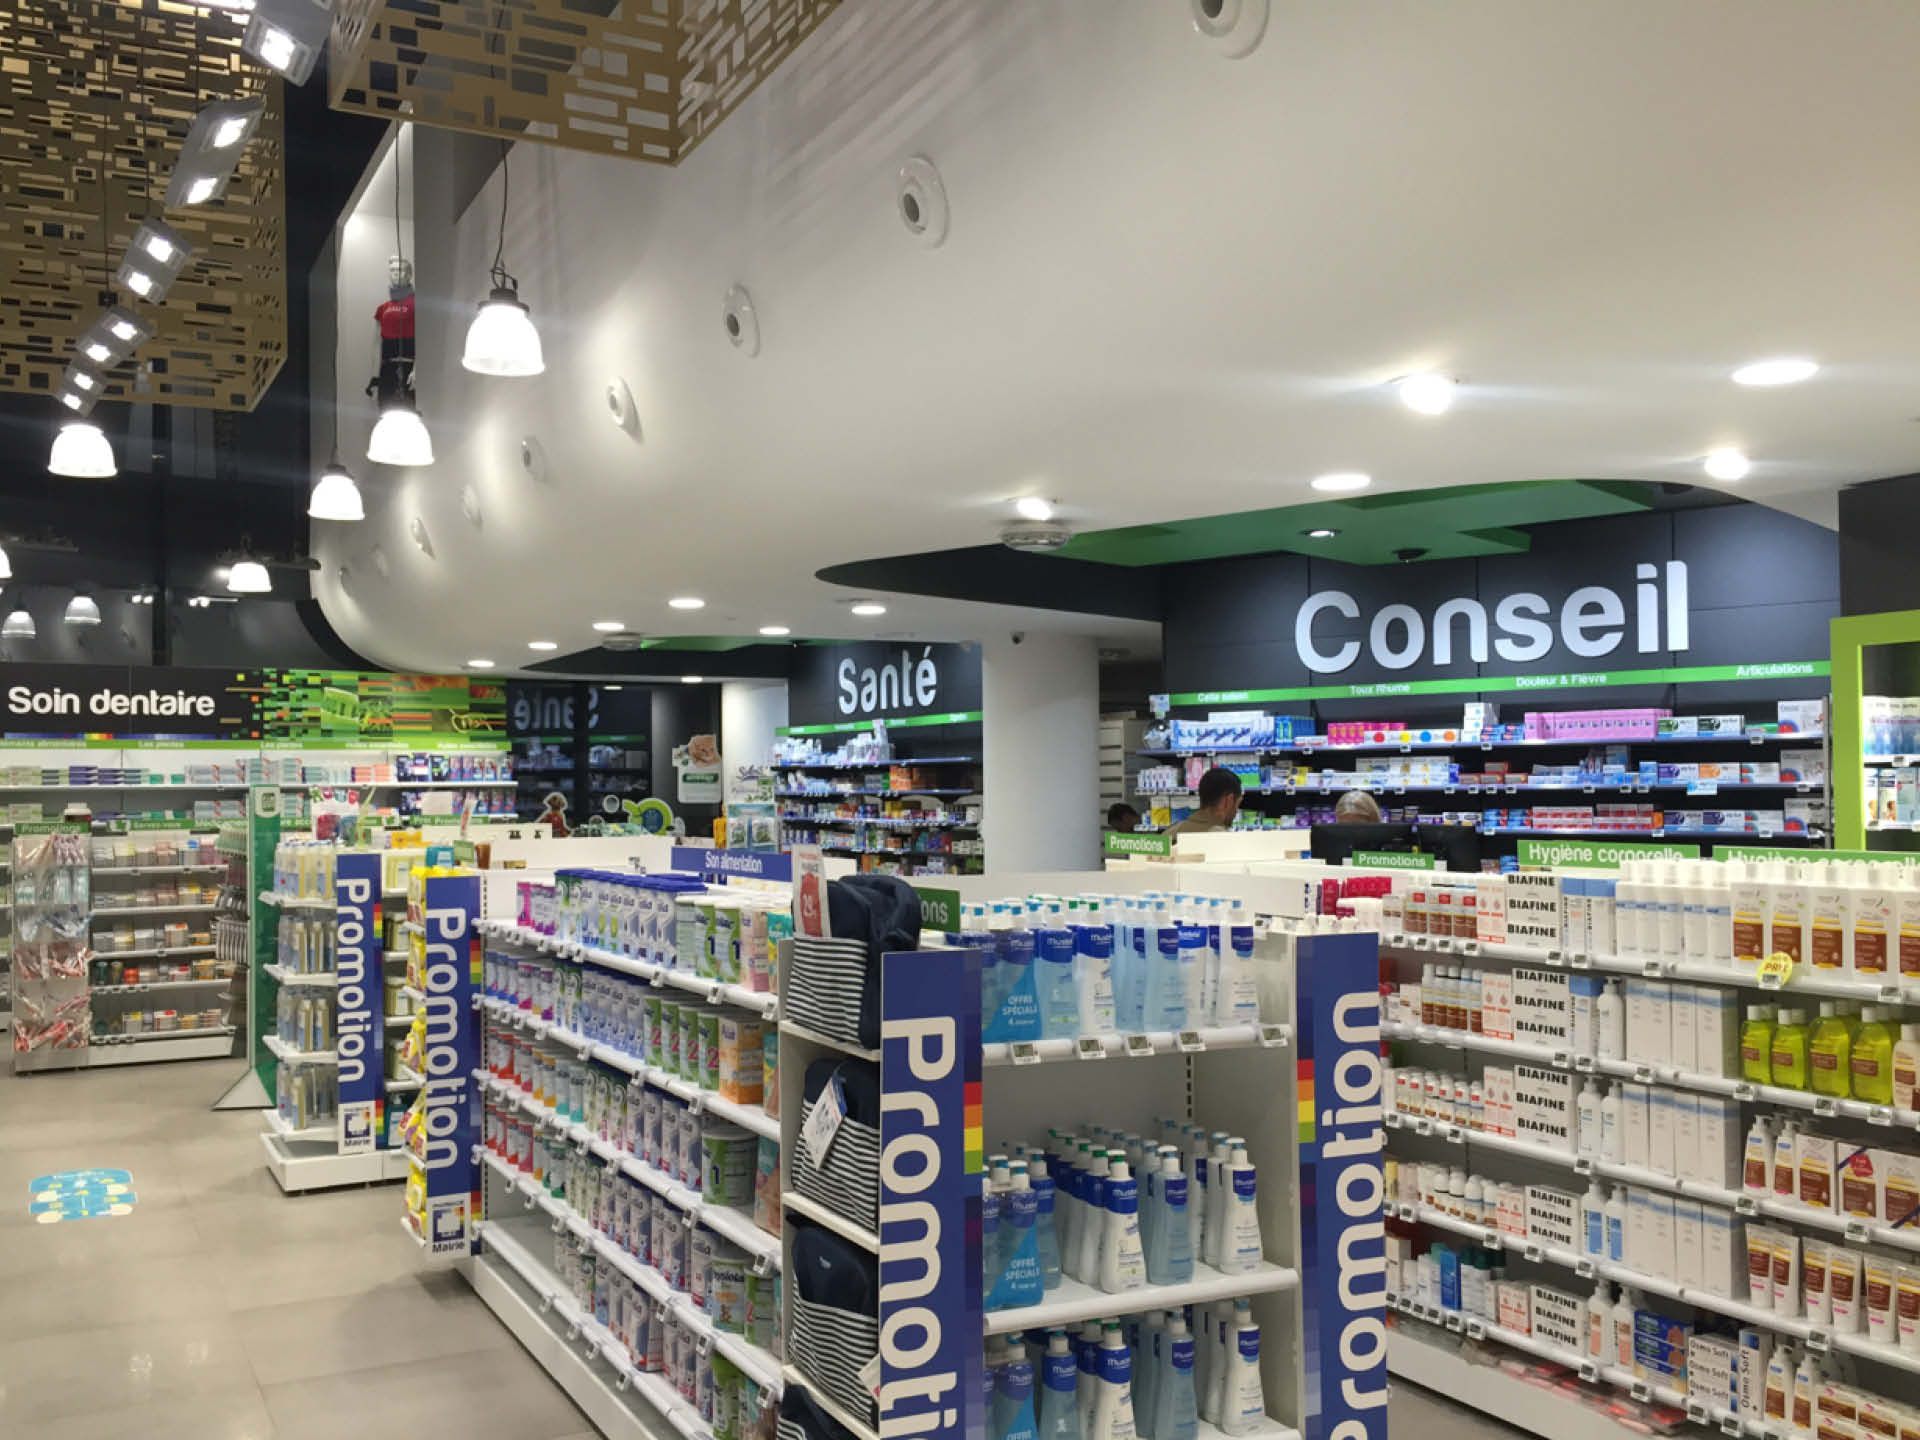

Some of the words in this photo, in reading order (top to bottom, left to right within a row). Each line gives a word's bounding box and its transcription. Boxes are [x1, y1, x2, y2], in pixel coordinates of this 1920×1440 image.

[1295, 560, 1690, 674] Conseil
[1735, 662, 1814, 677] Articulations
[838, 646, 937, 715] Santé
[1515, 675, 1557, 688] Douleur
[1559, 674, 1568, 685] &
[1570, 672, 1608, 684] Fièvre
[8, 686, 80, 714] Soin
[89, 688, 216, 716] dentaire
[22, 823, 81, 833] Promotions
[1110, 835, 1164, 852] Promotions
[705, 850, 720, 868] Son
[720, 852, 762, 873] alimentation
[1358, 853, 1426, 868] Promotions
[1529, 843, 1592, 866] Hygiène
[1508, 875, 1555, 886] BIAFINE
[1509, 899, 1557, 912] BIAFINE
[1507, 924, 1557, 937] BIAFINE
[336, 878, 371, 1083] Promotion
[1516, 970, 1566, 984] BIAFINE
[1515, 995, 1565, 1011] BIAFINE
[426, 907, 467, 1169] Promotion
[651, 1027, 662, 1045] 2
[1516, 1021, 1566, 1037] BIAFINE
[670, 1034, 680, 1053] 2
[688, 1040, 699, 1061] 2
[707, 1048, 720, 1069] 2
[1518, 1067, 1568, 1085] BIAFINE
[1516, 1093, 1565, 1111] BIAFINE
[1518, 1118, 1567, 1137] BIAFINE
[712, 1165, 719, 1184] 1
[1530, 1189, 1572, 1207] BIAFINE
[1530, 1207, 1572, 1226] BIAFINE
[1531, 1225, 1571, 1244] BIAFINE
[432, 1241, 465, 1253] Mairie
[1536, 1289, 1577, 1310] BIAFINE
[1536, 1306, 1576, 1328] BIAFINE
[1537, 1324, 1577, 1346] BIAFINE
[1741, 1350, 1750, 1374] Soft
